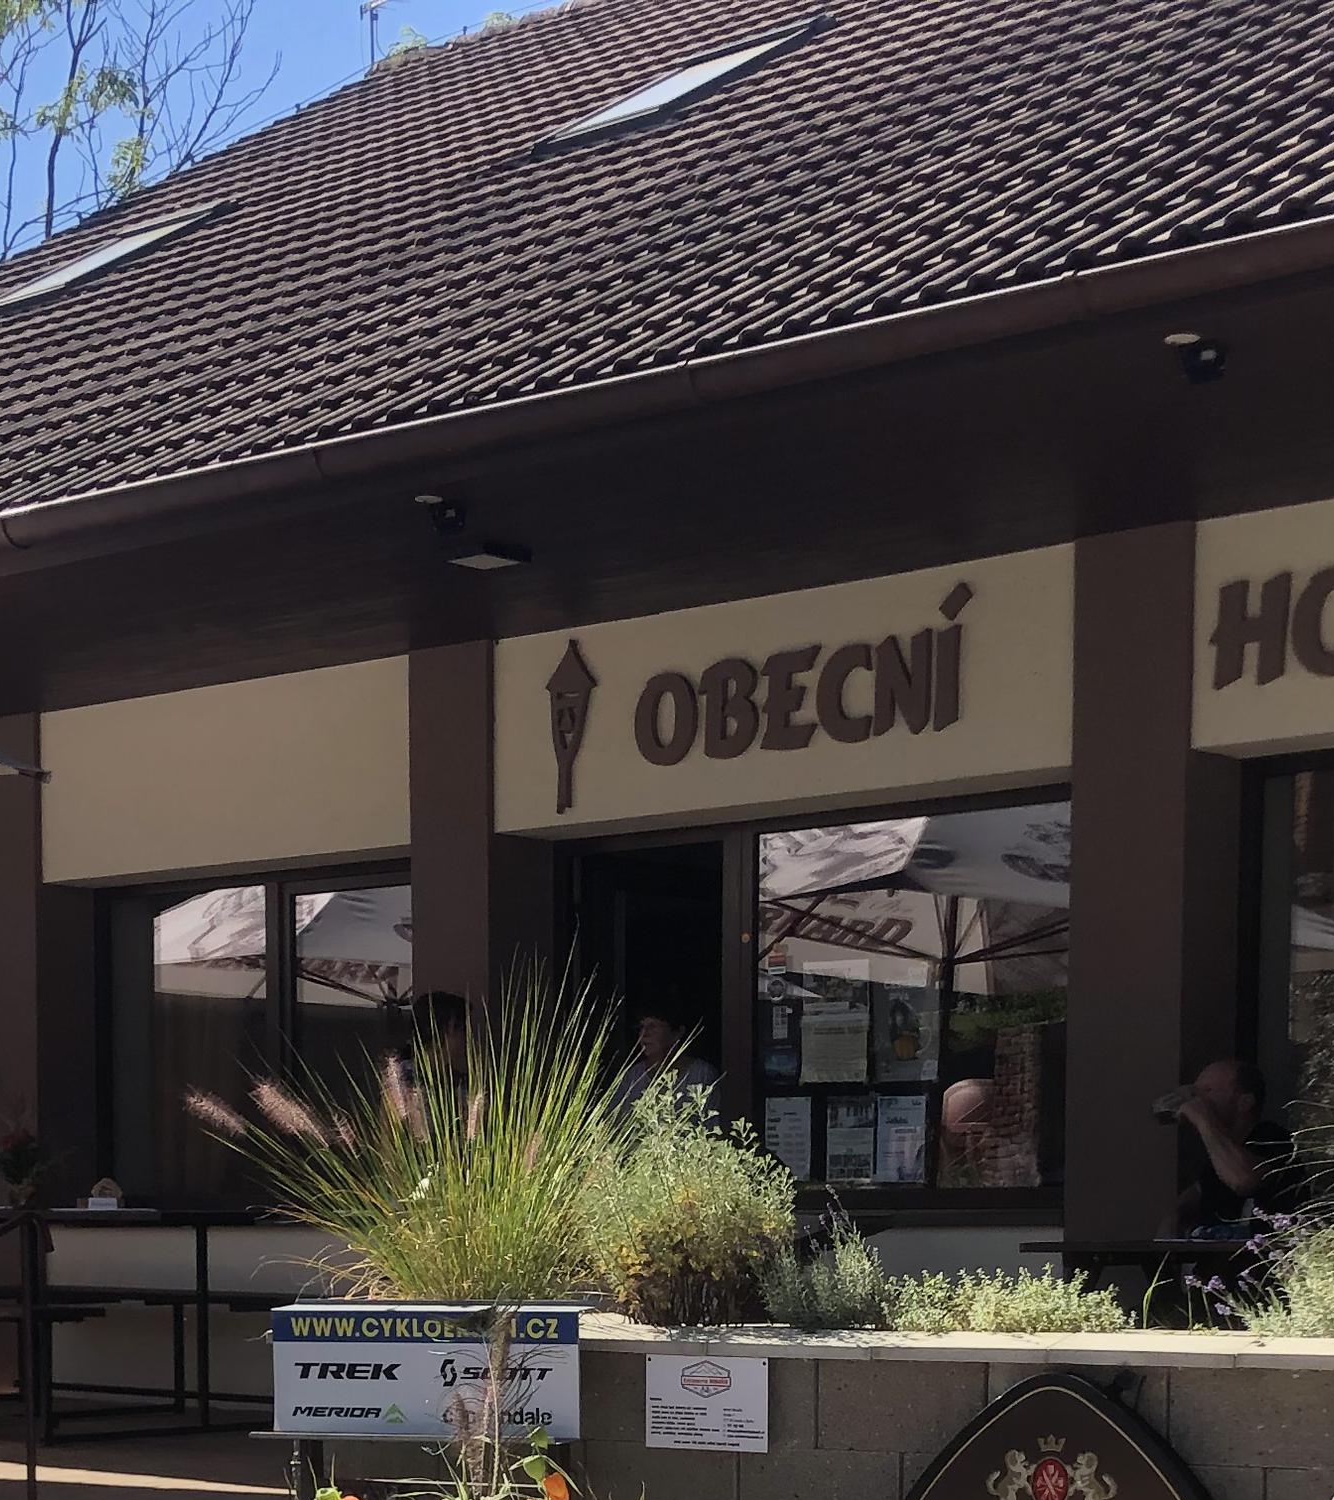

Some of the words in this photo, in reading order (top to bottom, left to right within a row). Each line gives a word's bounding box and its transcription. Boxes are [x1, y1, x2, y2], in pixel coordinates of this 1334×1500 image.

[634, 582, 973, 766] OBECNÍ
[294, 1362, 402, 1381] TREK
[292, 1406, 383, 1419] MERIDA
